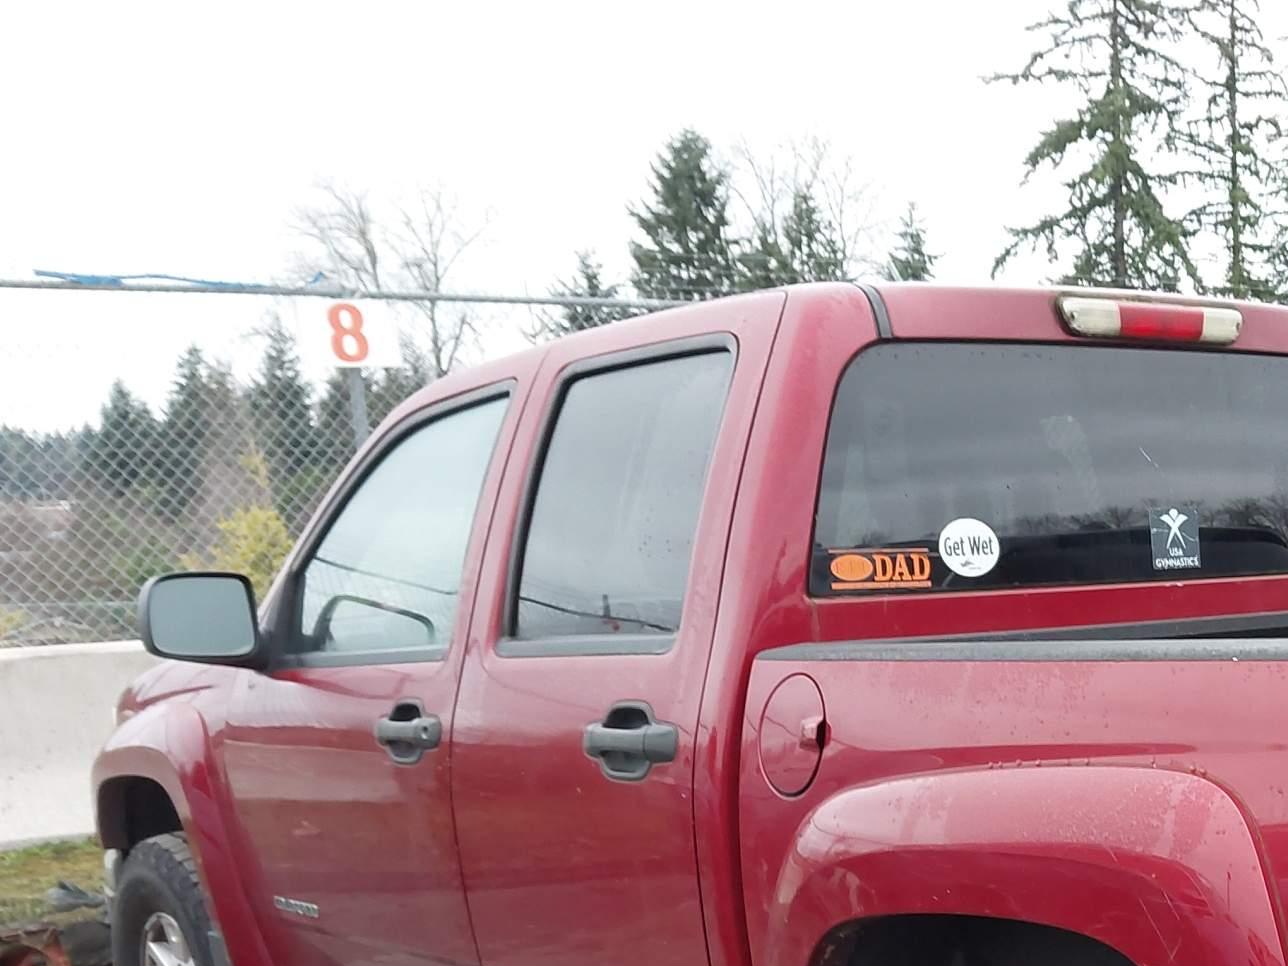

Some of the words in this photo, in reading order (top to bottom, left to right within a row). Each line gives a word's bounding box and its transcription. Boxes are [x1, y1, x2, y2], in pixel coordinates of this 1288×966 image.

[328, 303, 369, 362] 8
[944, 536, 965, 557] Get
[967, 536, 994, 556] Wet
[1169, 547, 1184, 557] USA
[872, 552, 931, 582] DAD
[1155, 556, 1199, 569] GYMNASTICS
